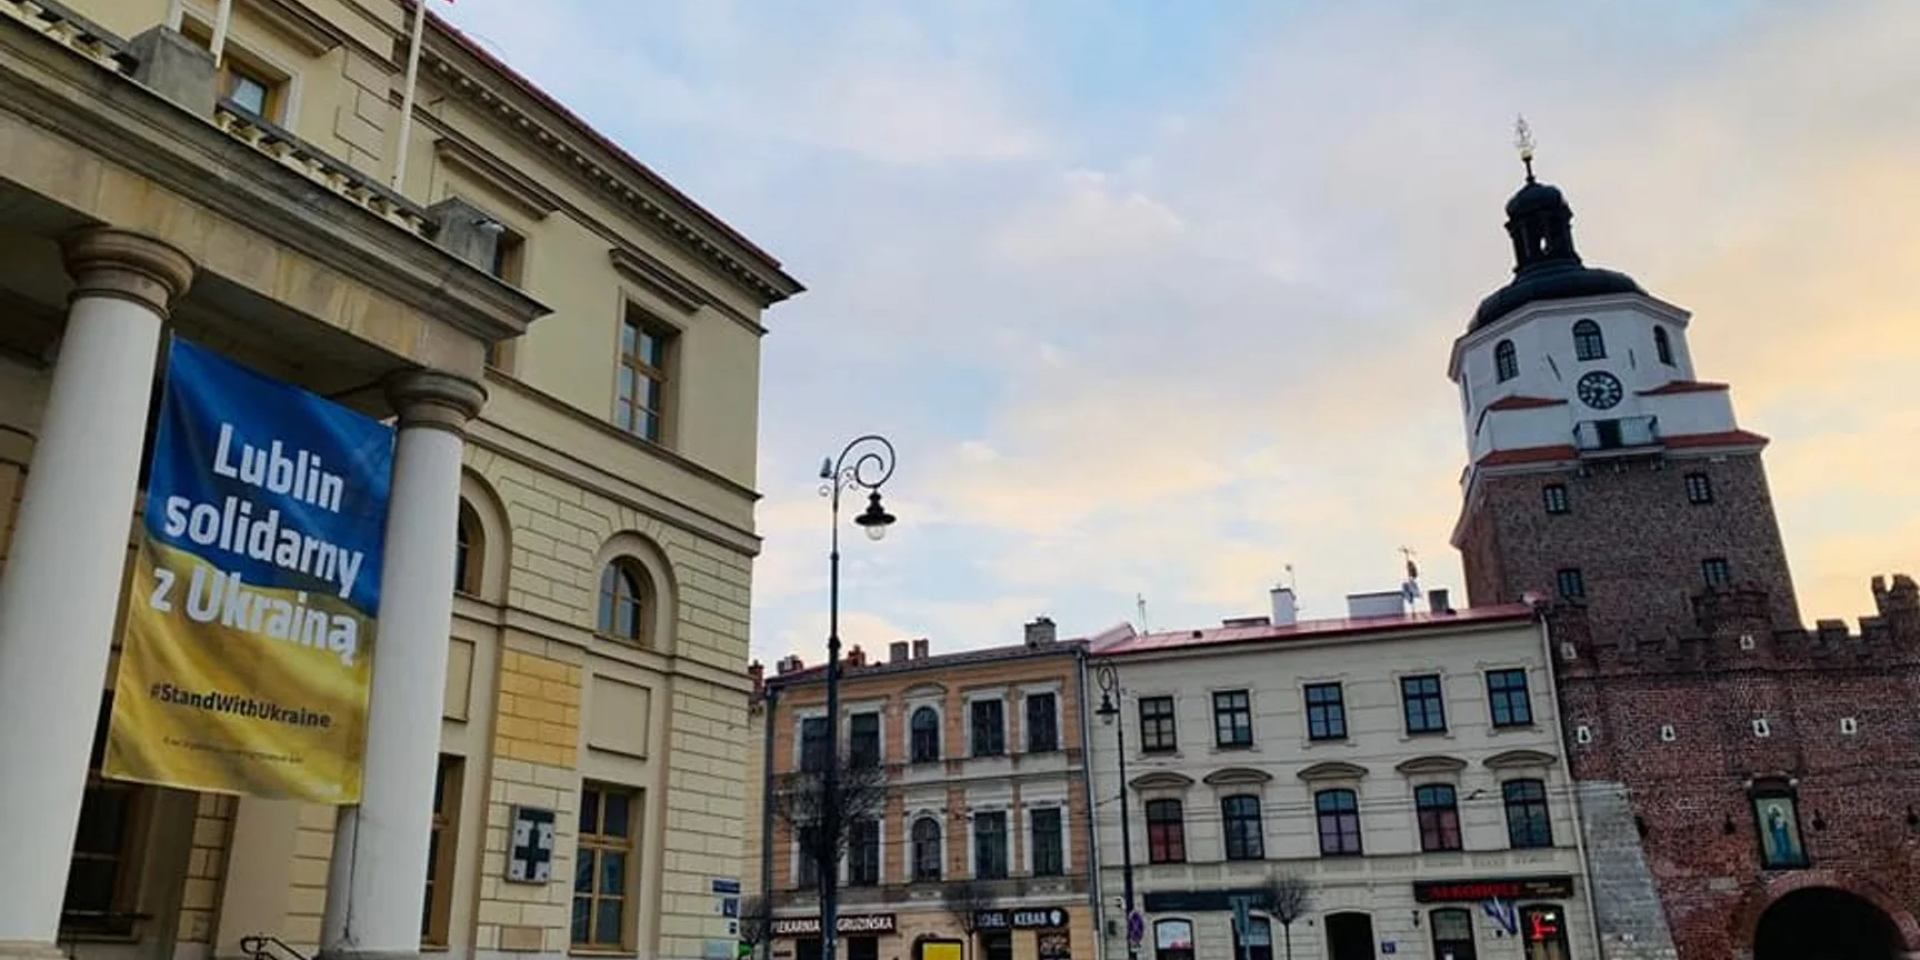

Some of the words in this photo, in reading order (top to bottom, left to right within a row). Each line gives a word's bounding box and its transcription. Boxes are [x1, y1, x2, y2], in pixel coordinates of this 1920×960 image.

[213, 422, 345, 513] Lublin
[164, 494, 364, 599] solidarny
[150, 567, 176, 613] z
[186, 564, 359, 667] Ukrainą
[151, 683, 332, 729] #StandWithUkraine
[1014, 911, 1047, 926] KEBAB
